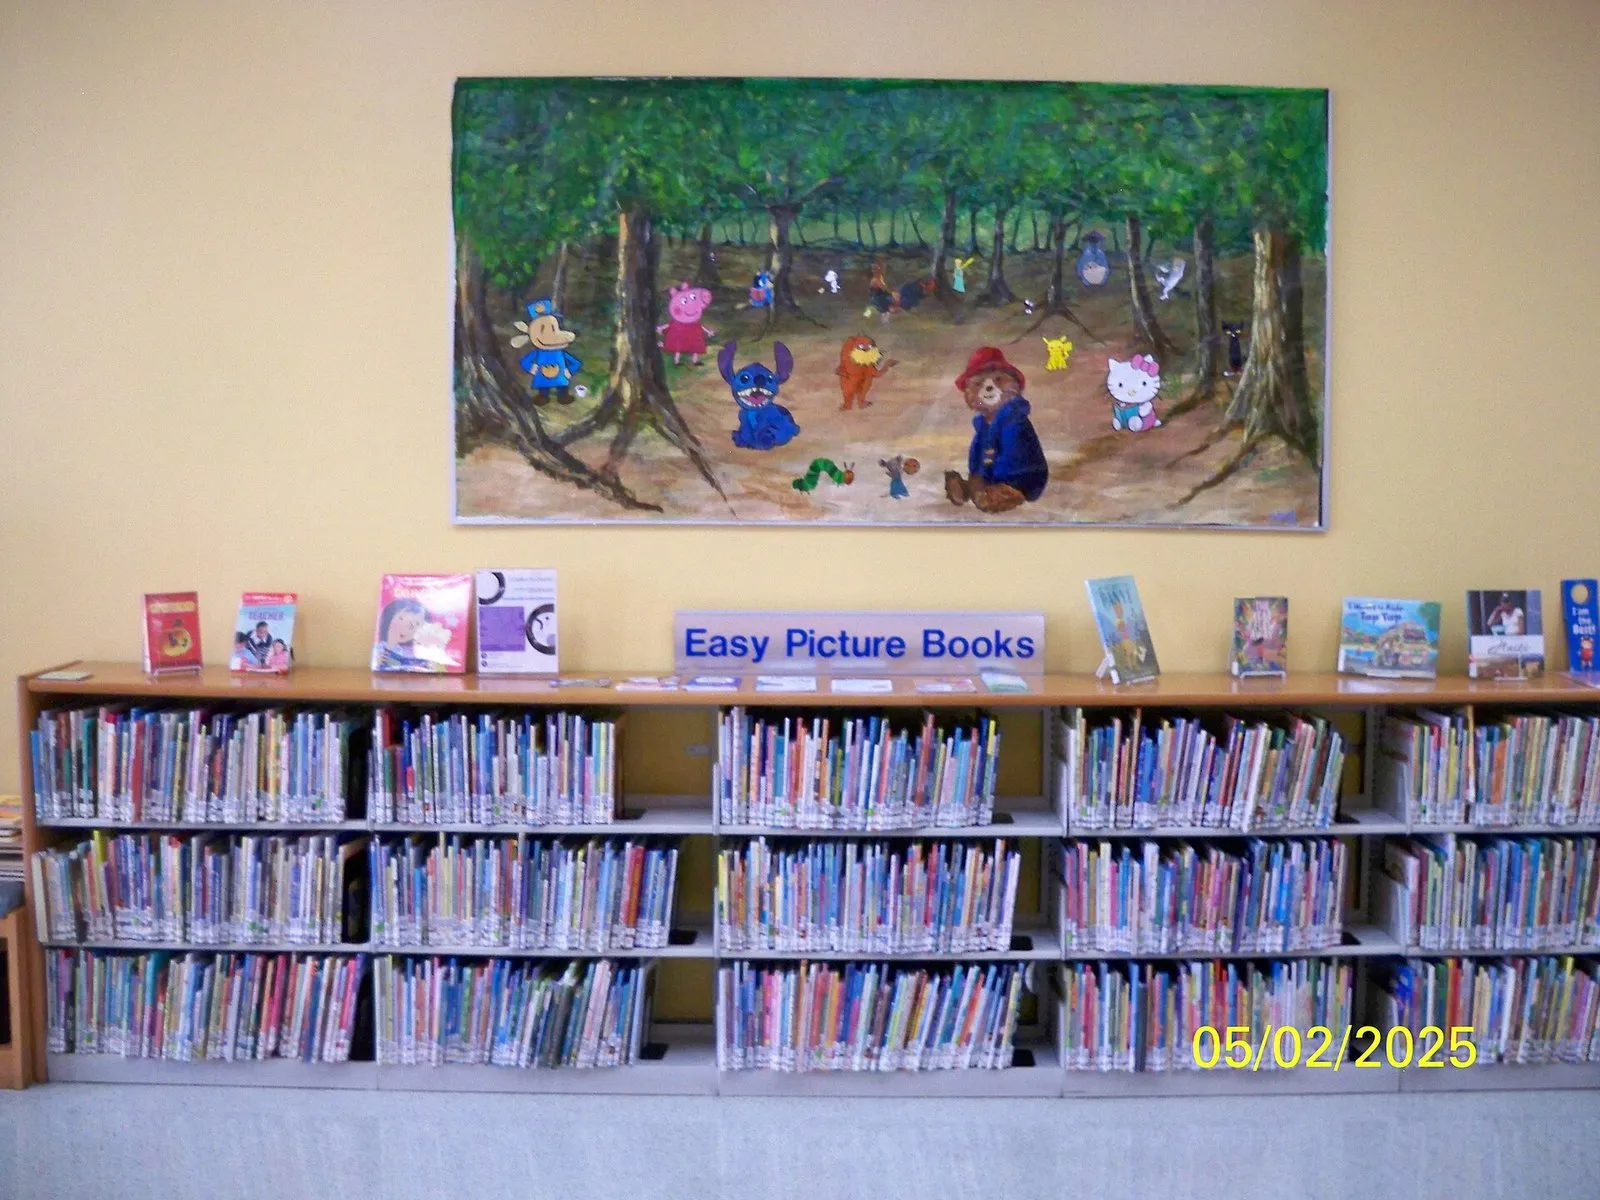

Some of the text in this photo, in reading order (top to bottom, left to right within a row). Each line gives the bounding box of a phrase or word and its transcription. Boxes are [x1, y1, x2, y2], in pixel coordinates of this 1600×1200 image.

[685, 628, 1035, 663] Easy Picture Books
